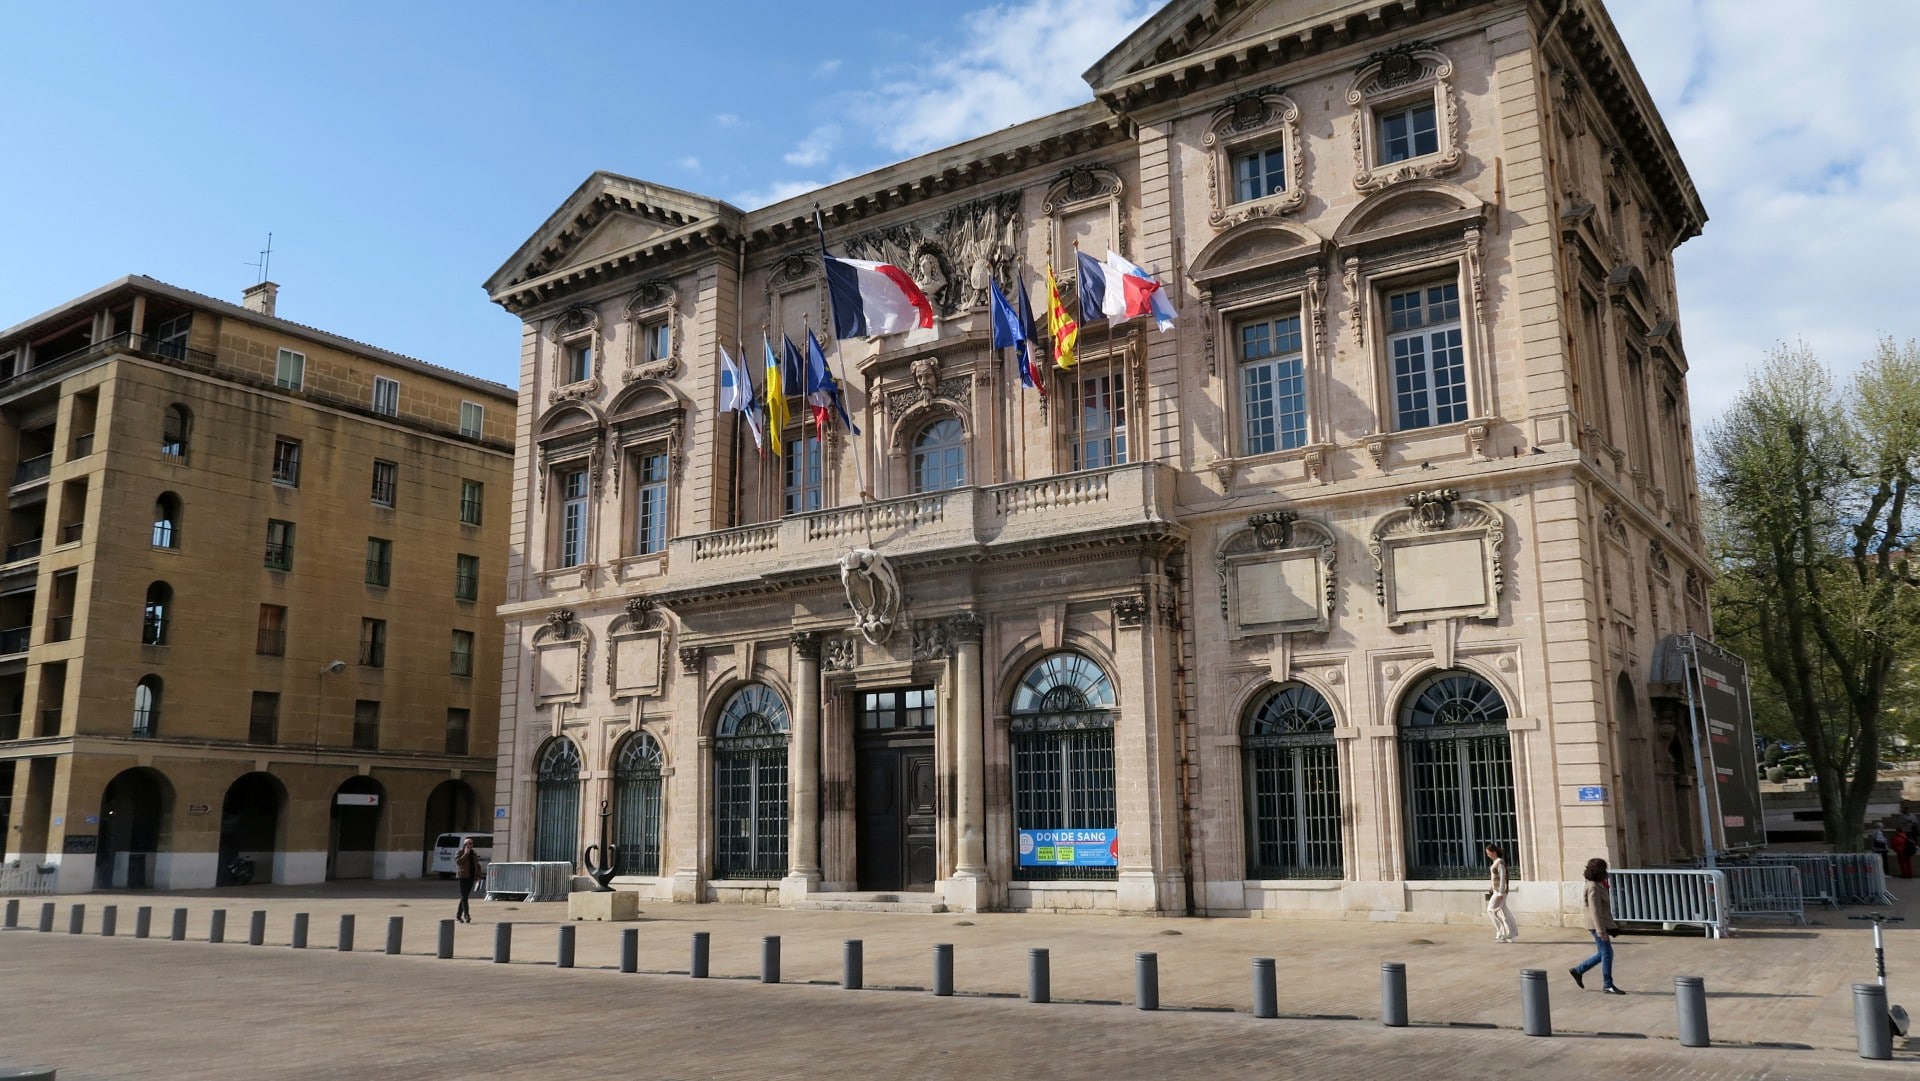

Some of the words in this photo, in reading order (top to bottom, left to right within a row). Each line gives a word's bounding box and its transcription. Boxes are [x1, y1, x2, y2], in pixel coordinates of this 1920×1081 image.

[1037, 832, 1059, 841] DON
[1061, 832, 1074, 841] DE
[1077, 832, 1106, 841] SANG
